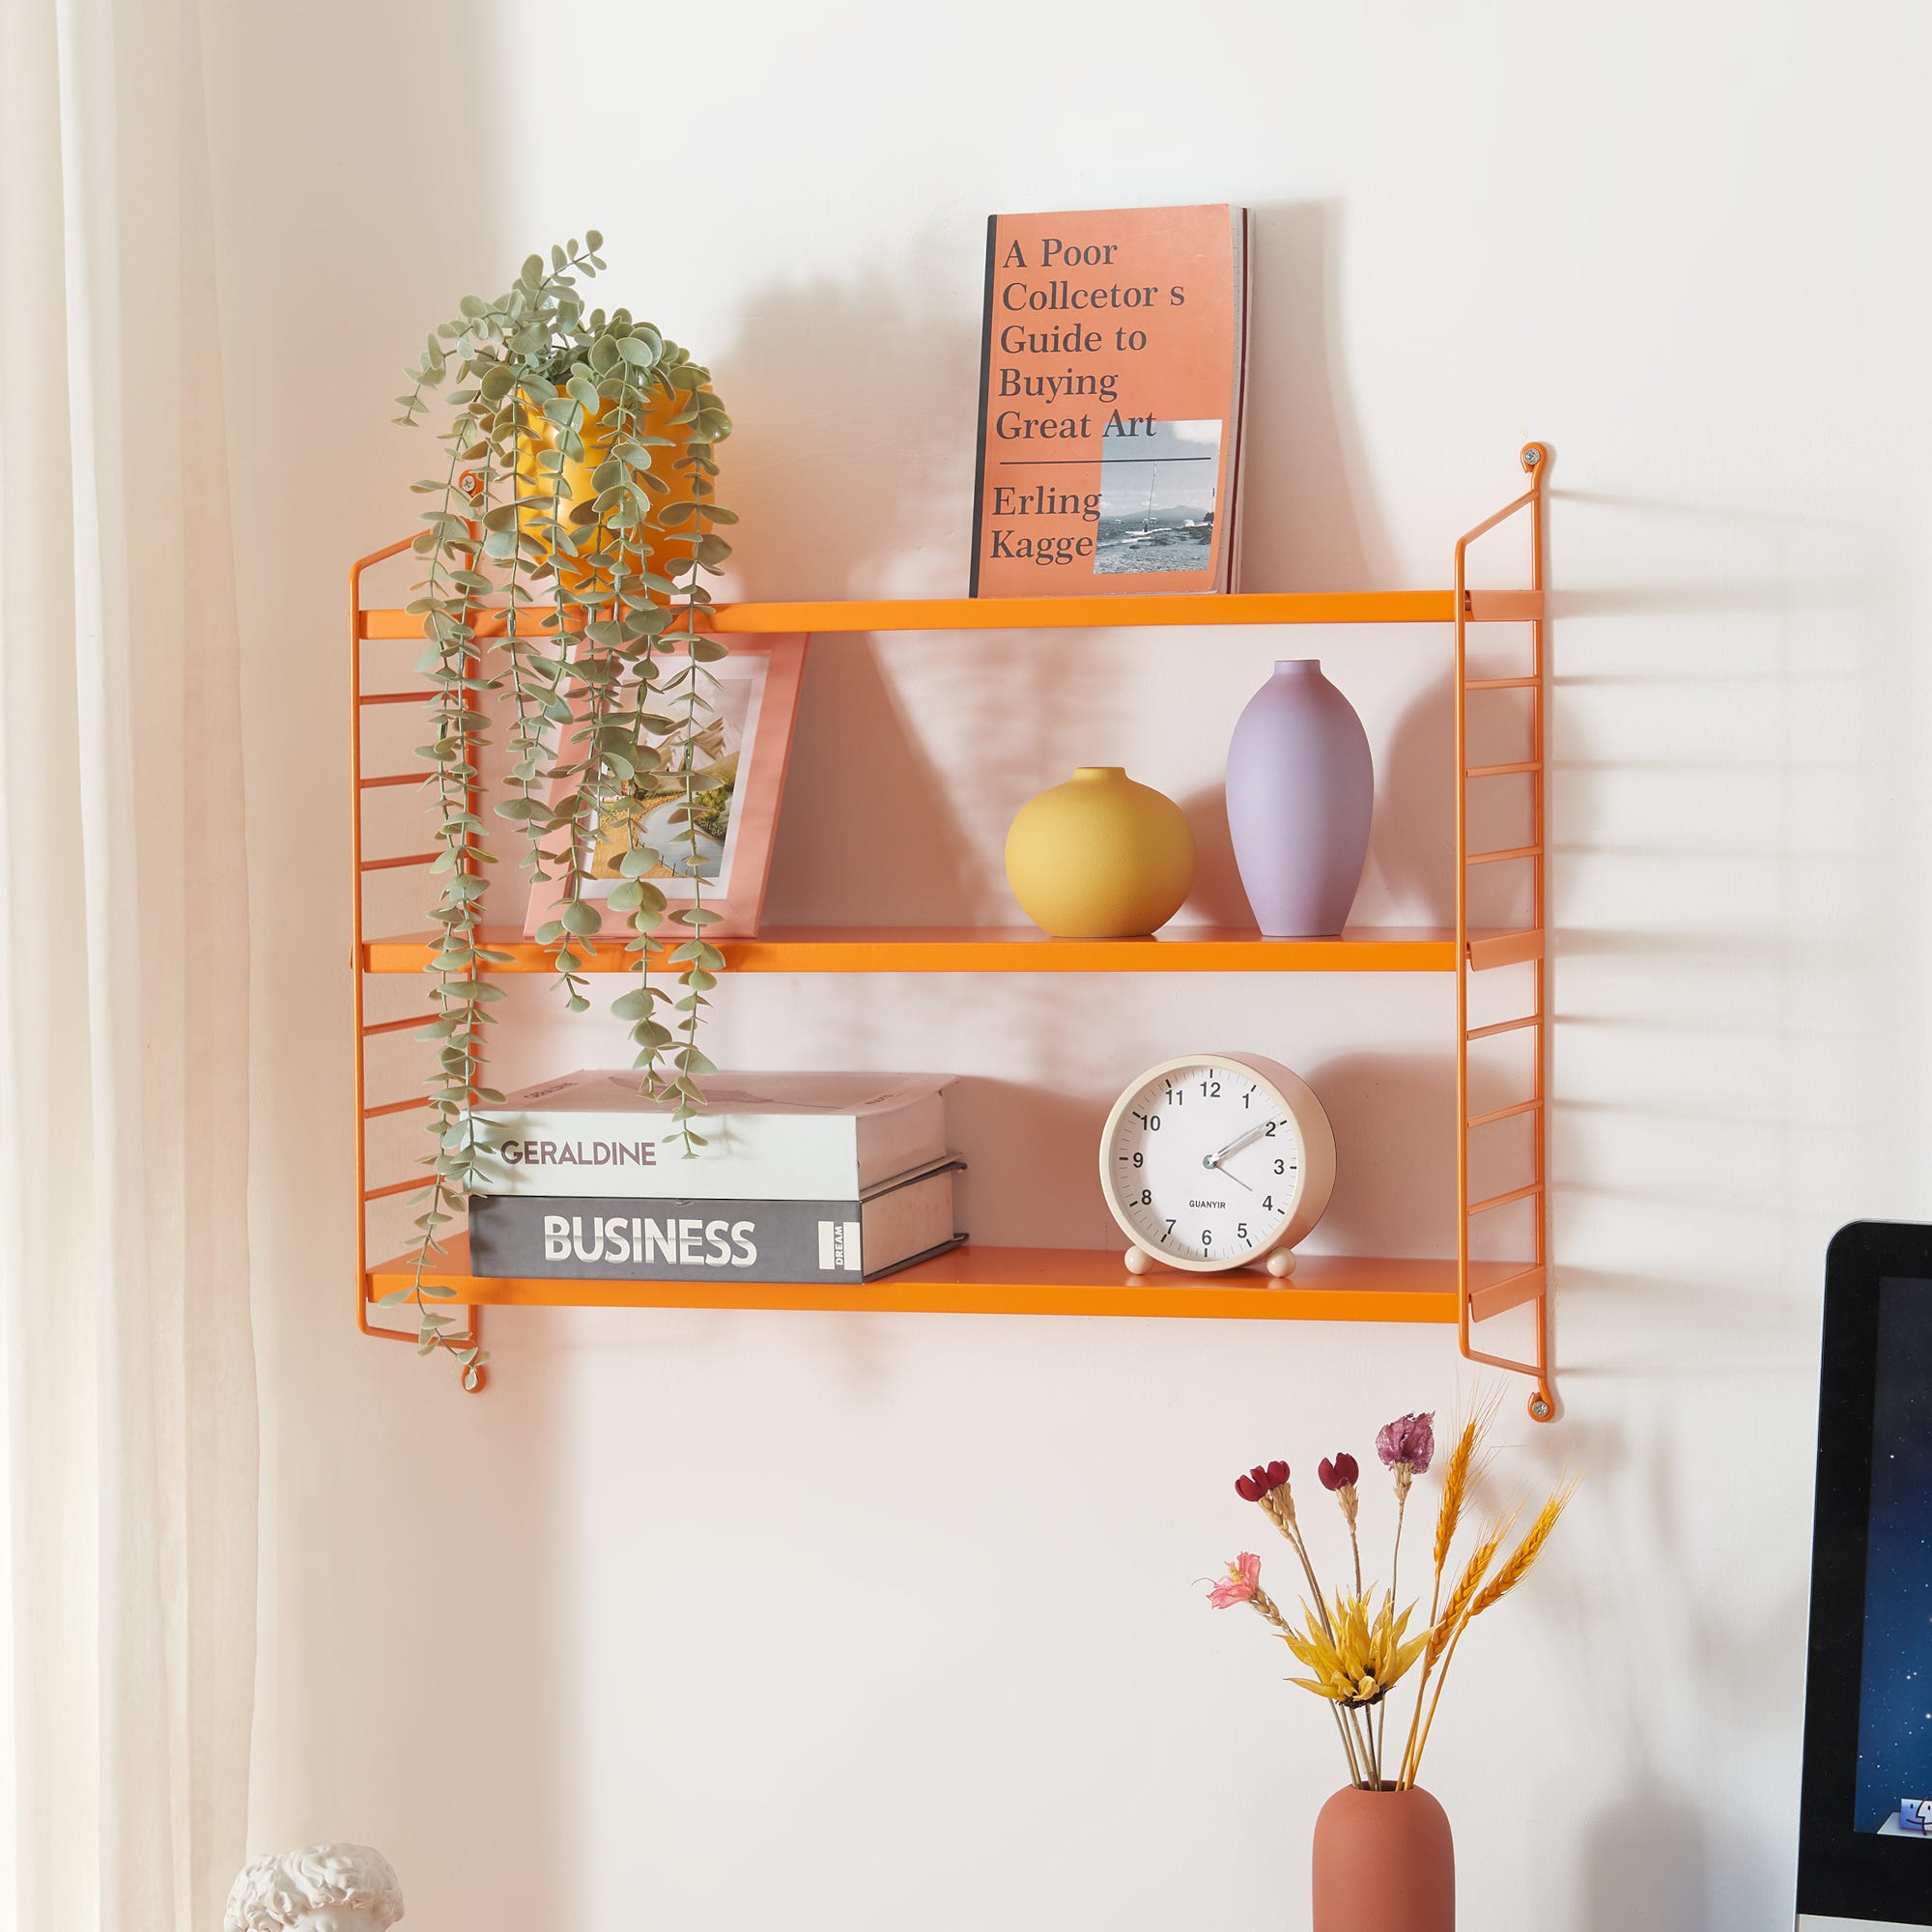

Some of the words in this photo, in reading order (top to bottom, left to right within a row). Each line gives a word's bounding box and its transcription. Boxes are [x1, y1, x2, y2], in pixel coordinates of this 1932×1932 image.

[1002, 239, 1027, 269] A
[1040, 238, 1118, 267] Poor
[1002, 281, 1158, 311] Collcetor
[1000, 324, 1102, 354] Guide
[1116, 327, 1147, 351] to
[998, 368, 1119, 403] Buying
[996, 411, 1091, 440] Great
[1102, 409, 1156, 438] Art
[992, 486, 1102, 520] Erling
[990, 529, 1093, 564] Kagge
[1165, 1090, 1183, 1105] 11
[1200, 1082, 1221, 1097] 12
[1242, 1094, 1250, 1108] 1
[1140, 1115, 1161, 1131] 10
[1265, 1122, 1276, 1137] 2
[500, 1140, 657, 1166] GERALDINE
[1133, 1152, 1144, 1168] 9
[1273, 1159, 1285, 1175] 3
[1141, 1189, 1151, 1206] 8
[1189, 1200, 1226, 1209] GUANYIR
[1262, 1196, 1273, 1210] 4
[1165, 1219, 1177, 1235] 7
[1236, 1223, 1248, 1238] 5
[544, 1215, 757, 1267] BUSINESS
[835, 1226, 843, 1265] DREAM
[1202, 1230, 1212, 1245] 6
